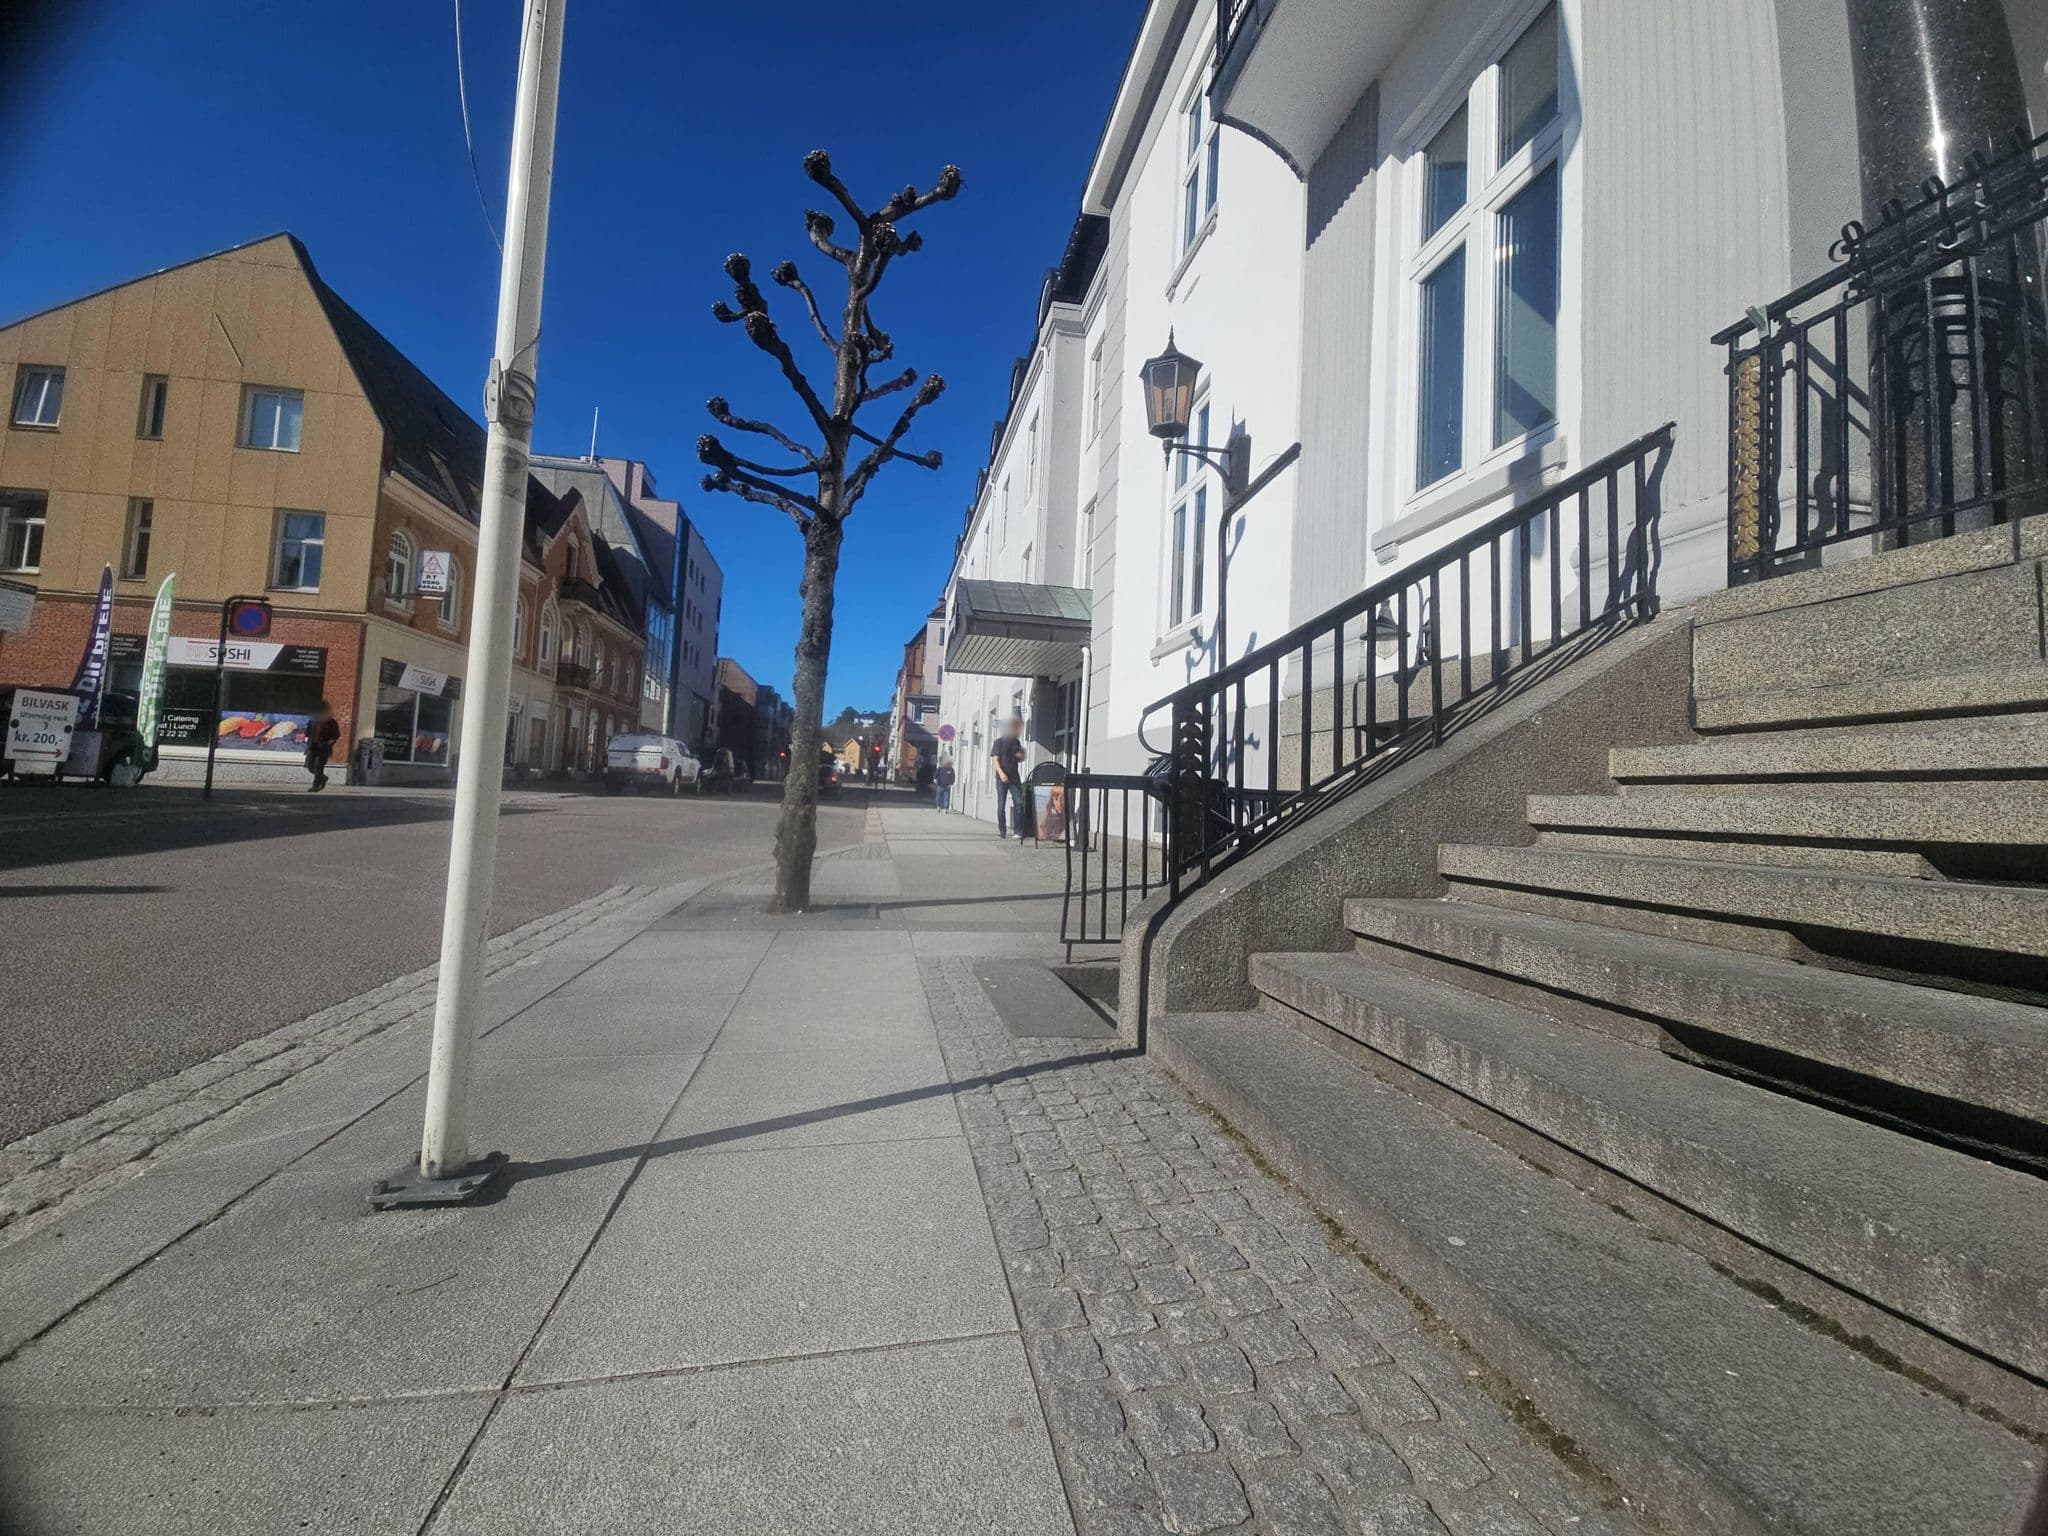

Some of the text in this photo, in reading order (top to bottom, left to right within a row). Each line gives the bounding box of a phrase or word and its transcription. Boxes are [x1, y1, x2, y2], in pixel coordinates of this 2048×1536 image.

[21, 696, 69, 711] BILVASK
[167, 714, 199, 724] Catering
[14, 730, 64, 746] kr. 200,-
[177, 730, 188, 738] 22
